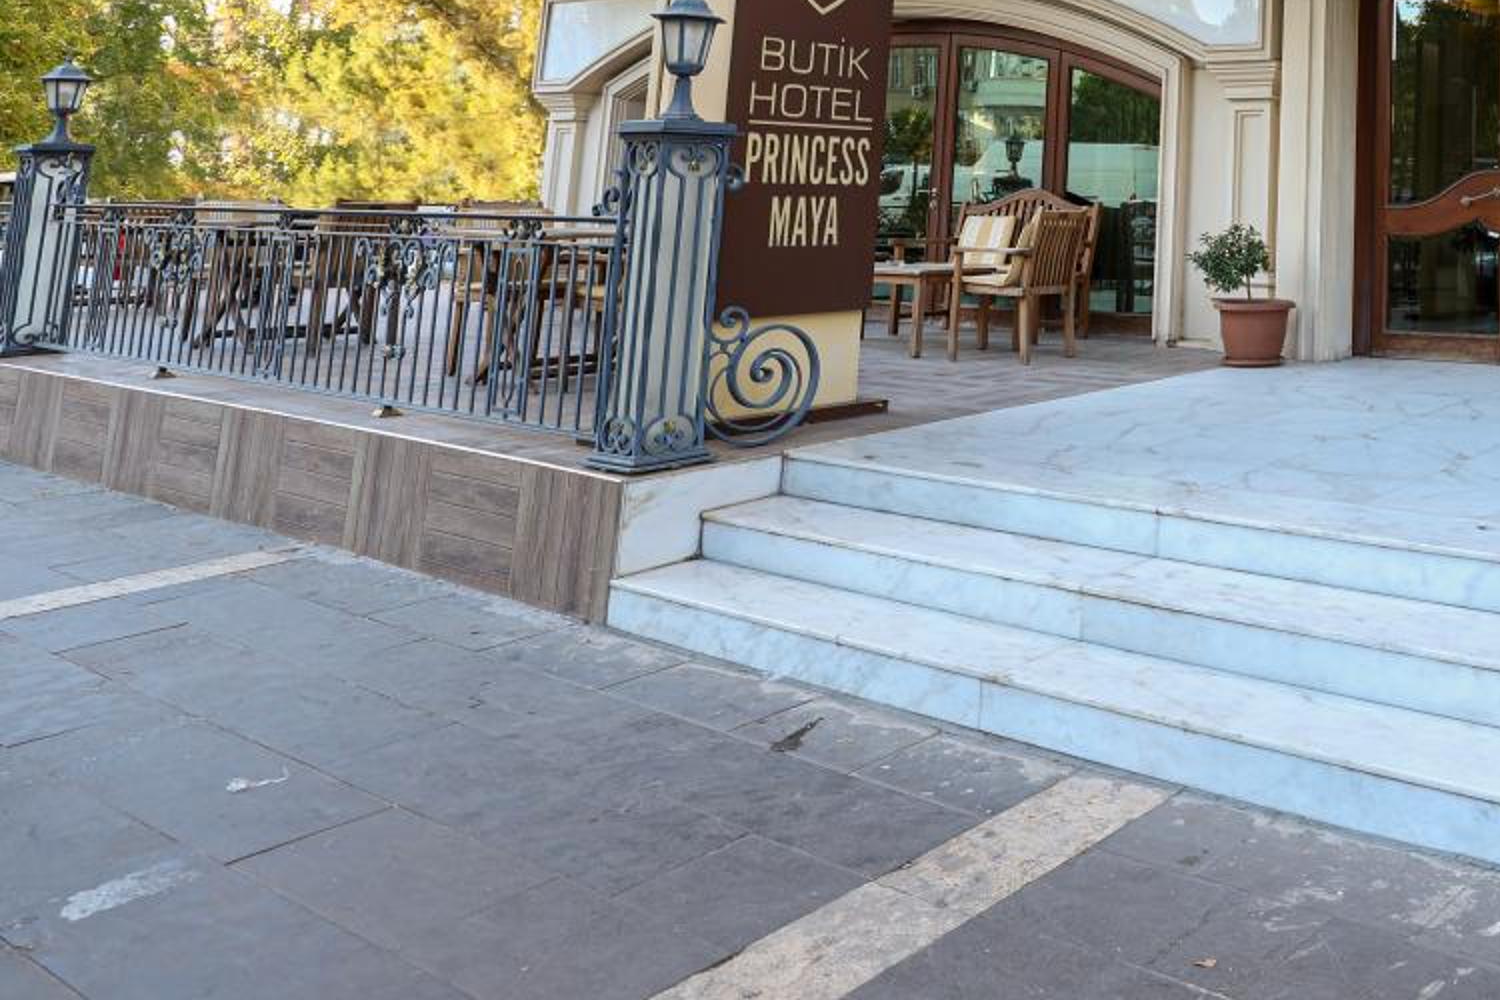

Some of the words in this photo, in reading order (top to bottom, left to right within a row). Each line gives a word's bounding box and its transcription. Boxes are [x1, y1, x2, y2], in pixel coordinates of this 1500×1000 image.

[761, 36, 870, 80] BUTİK
[748, 80, 873, 122] HOTEL
[744, 132, 871, 186] PRINCESS
[768, 195, 839, 248] MAYA
